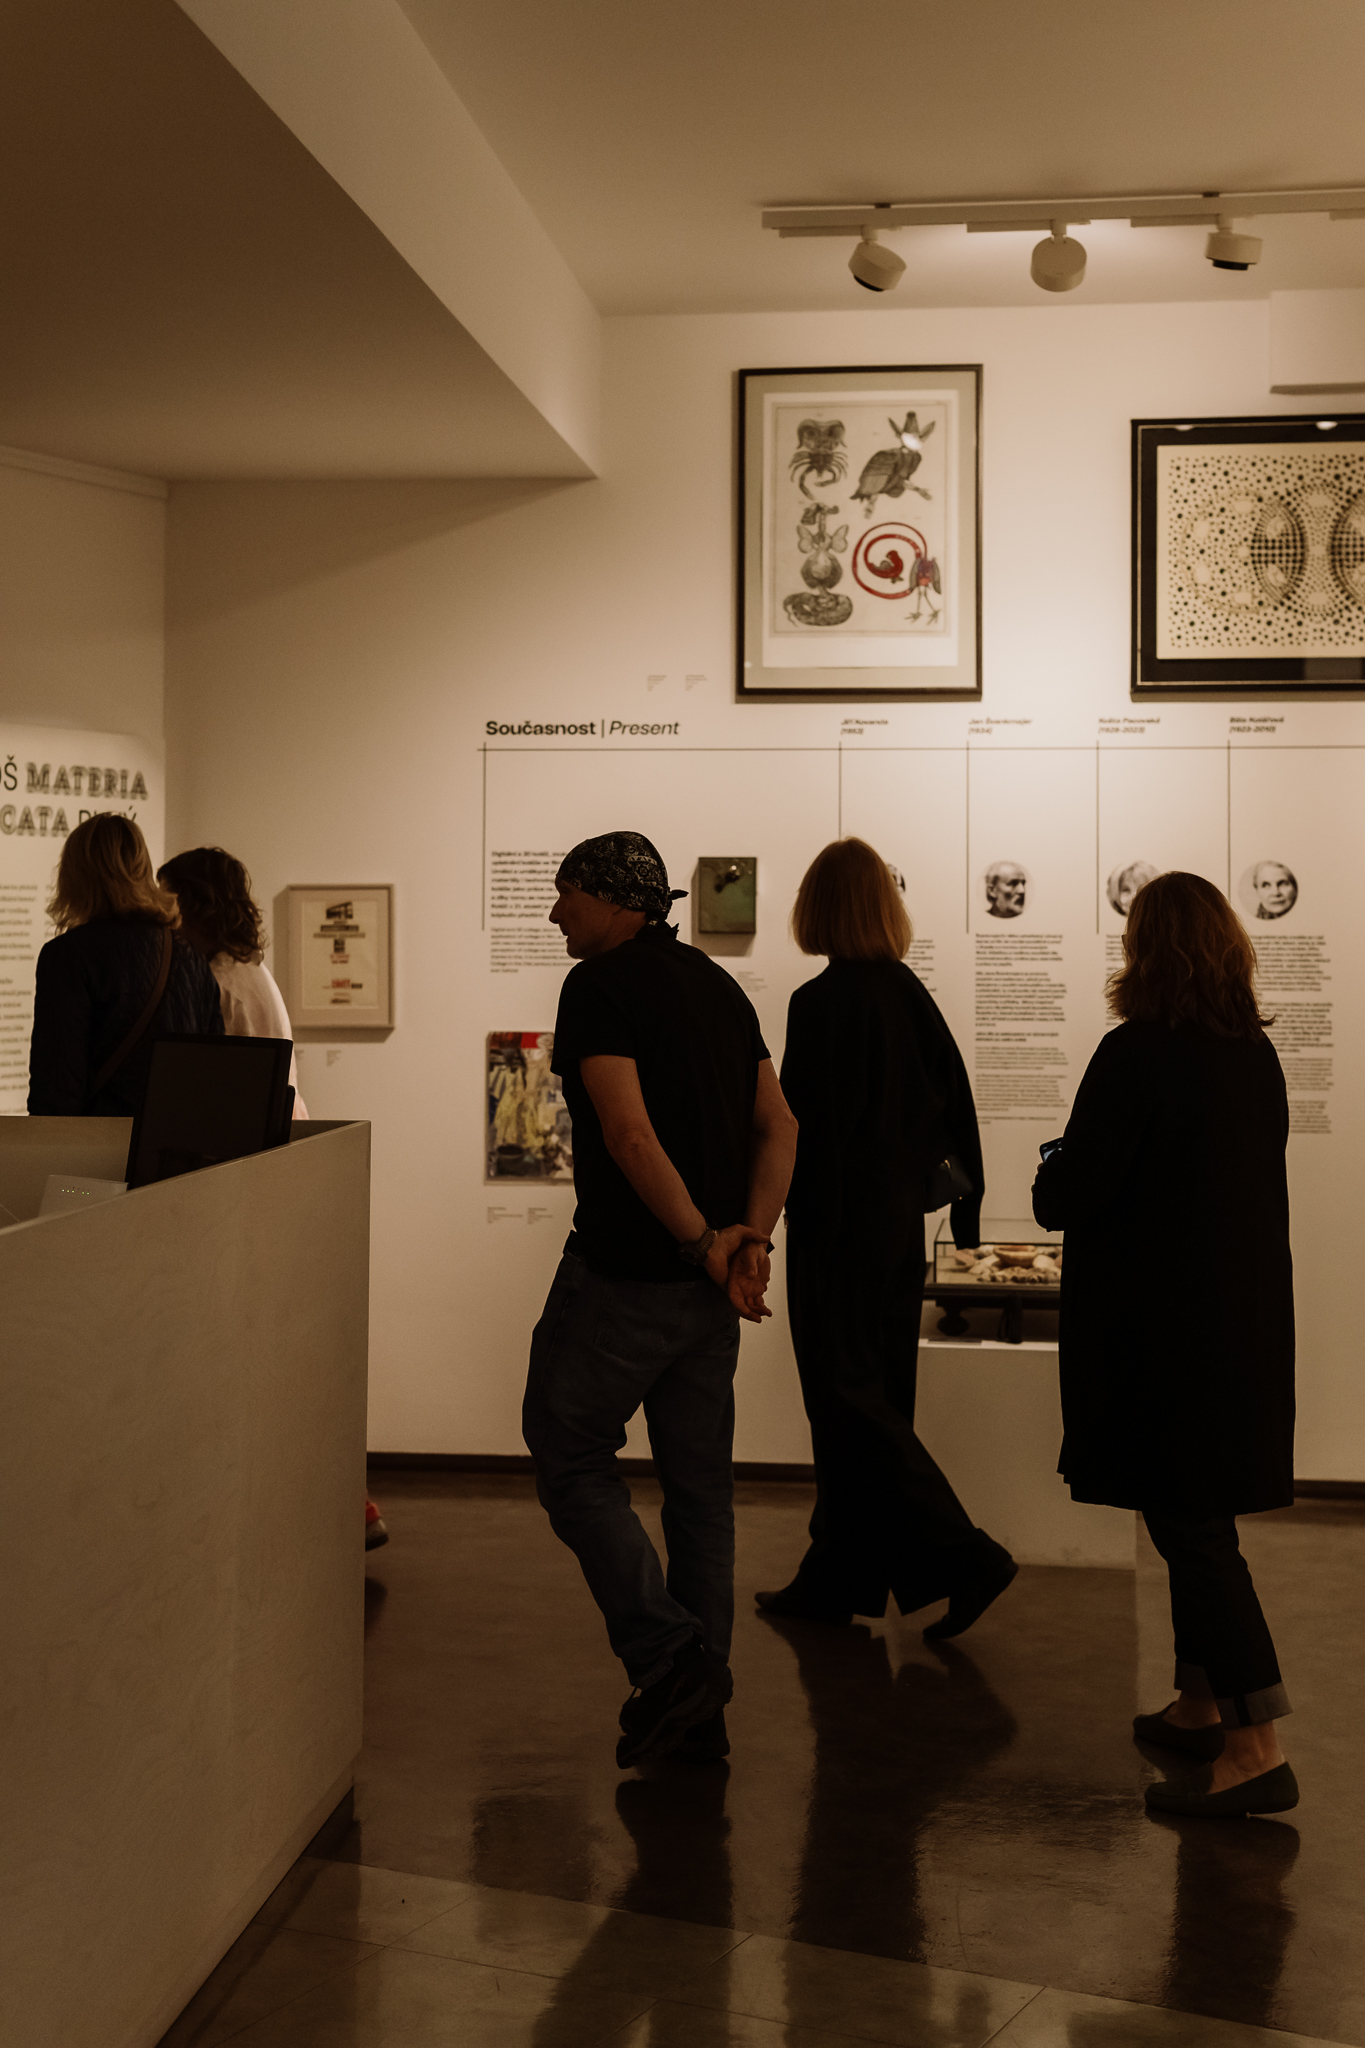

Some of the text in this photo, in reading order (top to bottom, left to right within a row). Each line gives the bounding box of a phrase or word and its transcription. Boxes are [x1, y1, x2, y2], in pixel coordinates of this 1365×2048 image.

[485, 720, 596, 736] Současnost
[609, 720, 680, 735] Present
[0, 754, 148, 801] Š MATERIA
